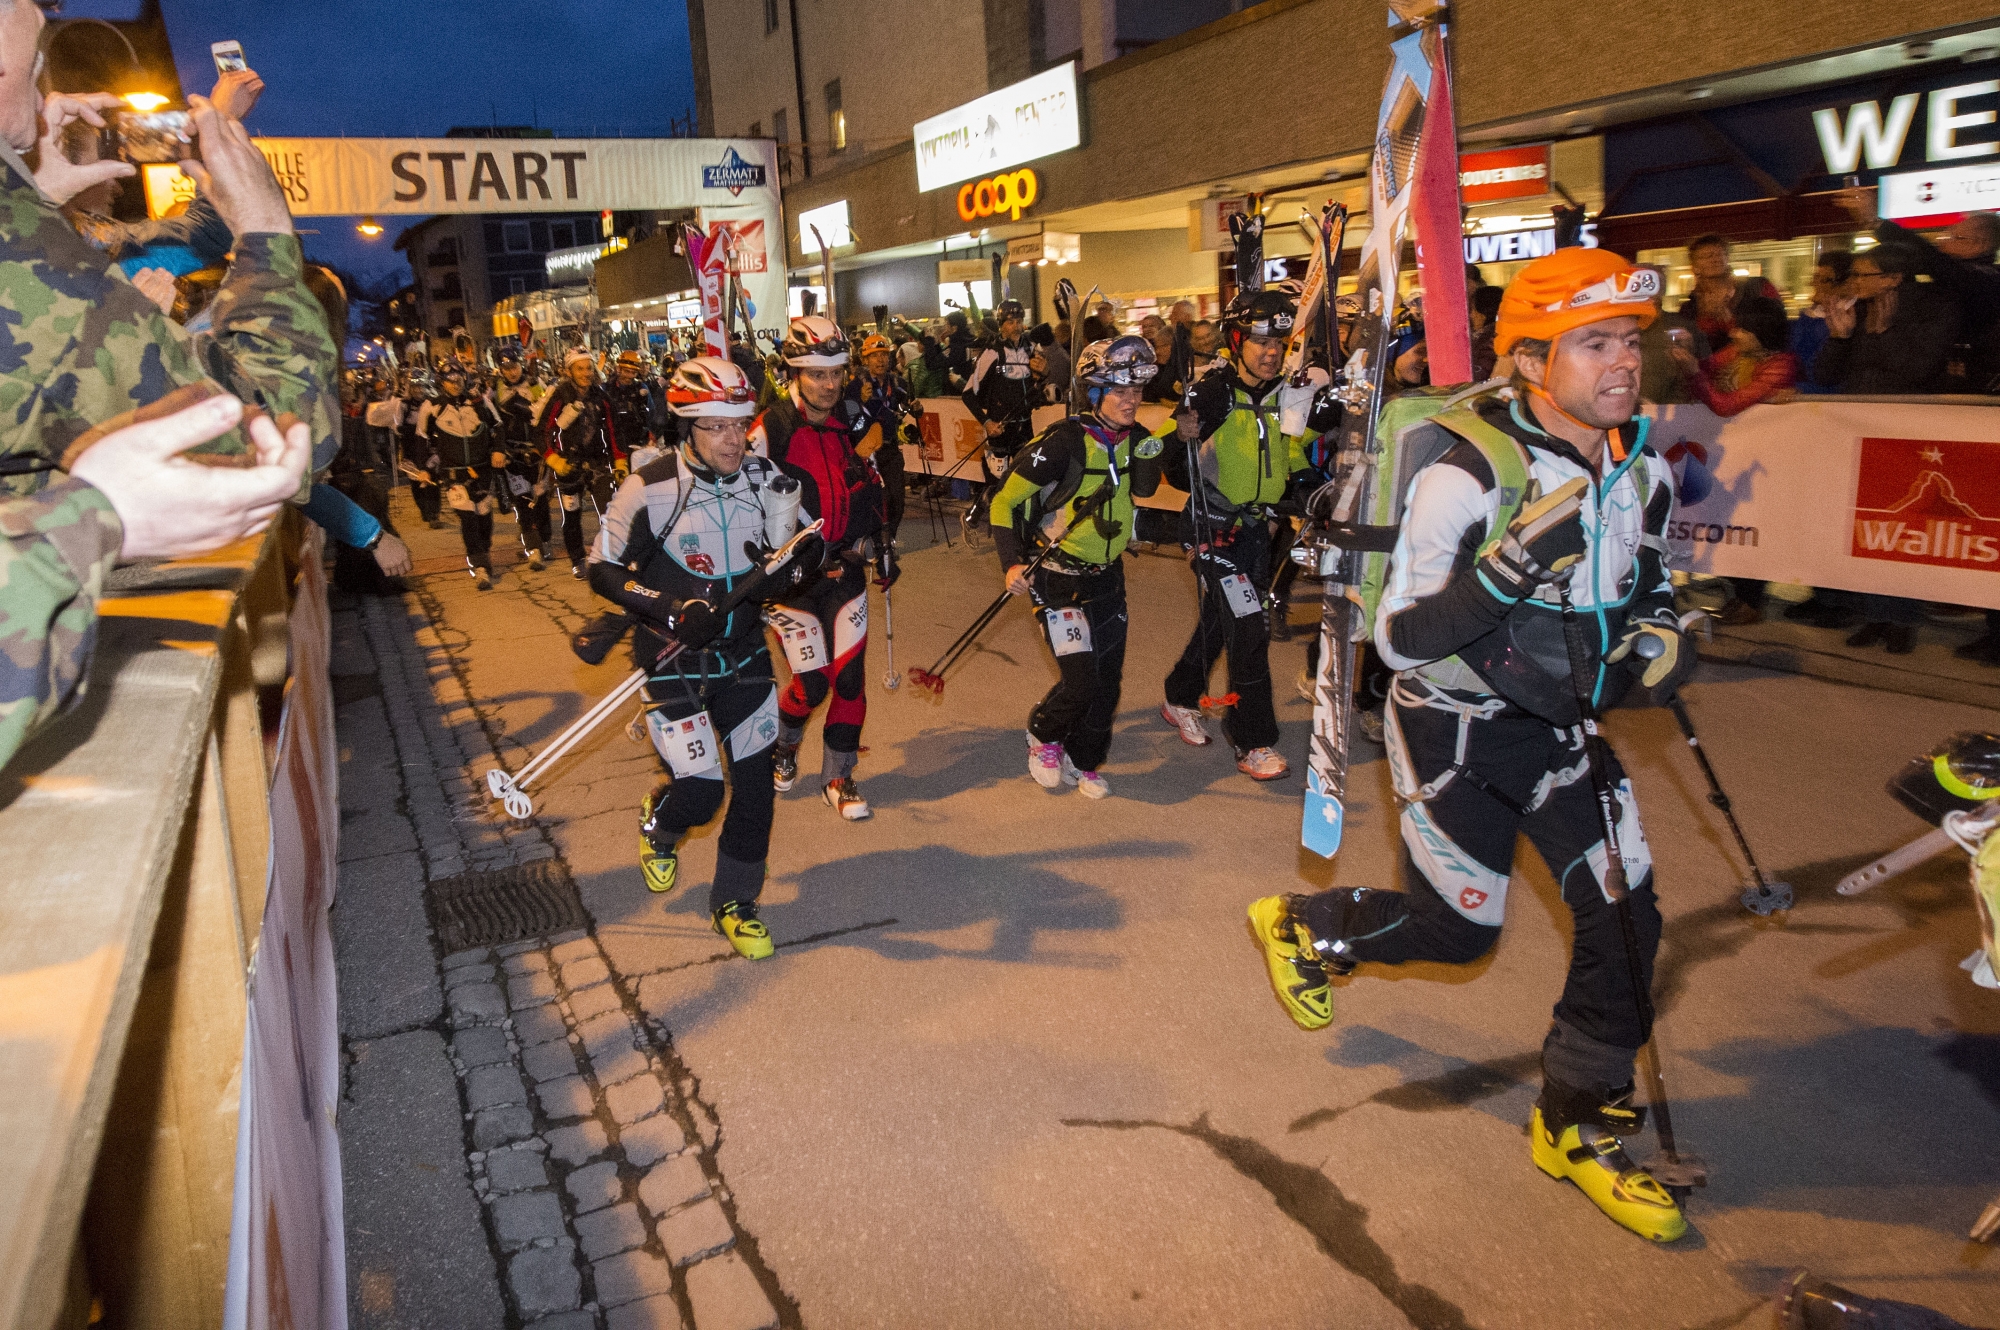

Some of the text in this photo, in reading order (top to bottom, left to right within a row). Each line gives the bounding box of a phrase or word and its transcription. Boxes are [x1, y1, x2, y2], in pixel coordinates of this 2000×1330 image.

[391, 151, 587, 202] START
[708, 167, 759, 181] ZERMATT
[957, 167, 1037, 222] coop
[1857, 519, 1999, 563] Wallis
[1243, 588, 1257, 604] 58
[1066, 626, 1083, 643] 58
[799, 644, 816, 662] 53
[686, 739, 706, 761] 53
